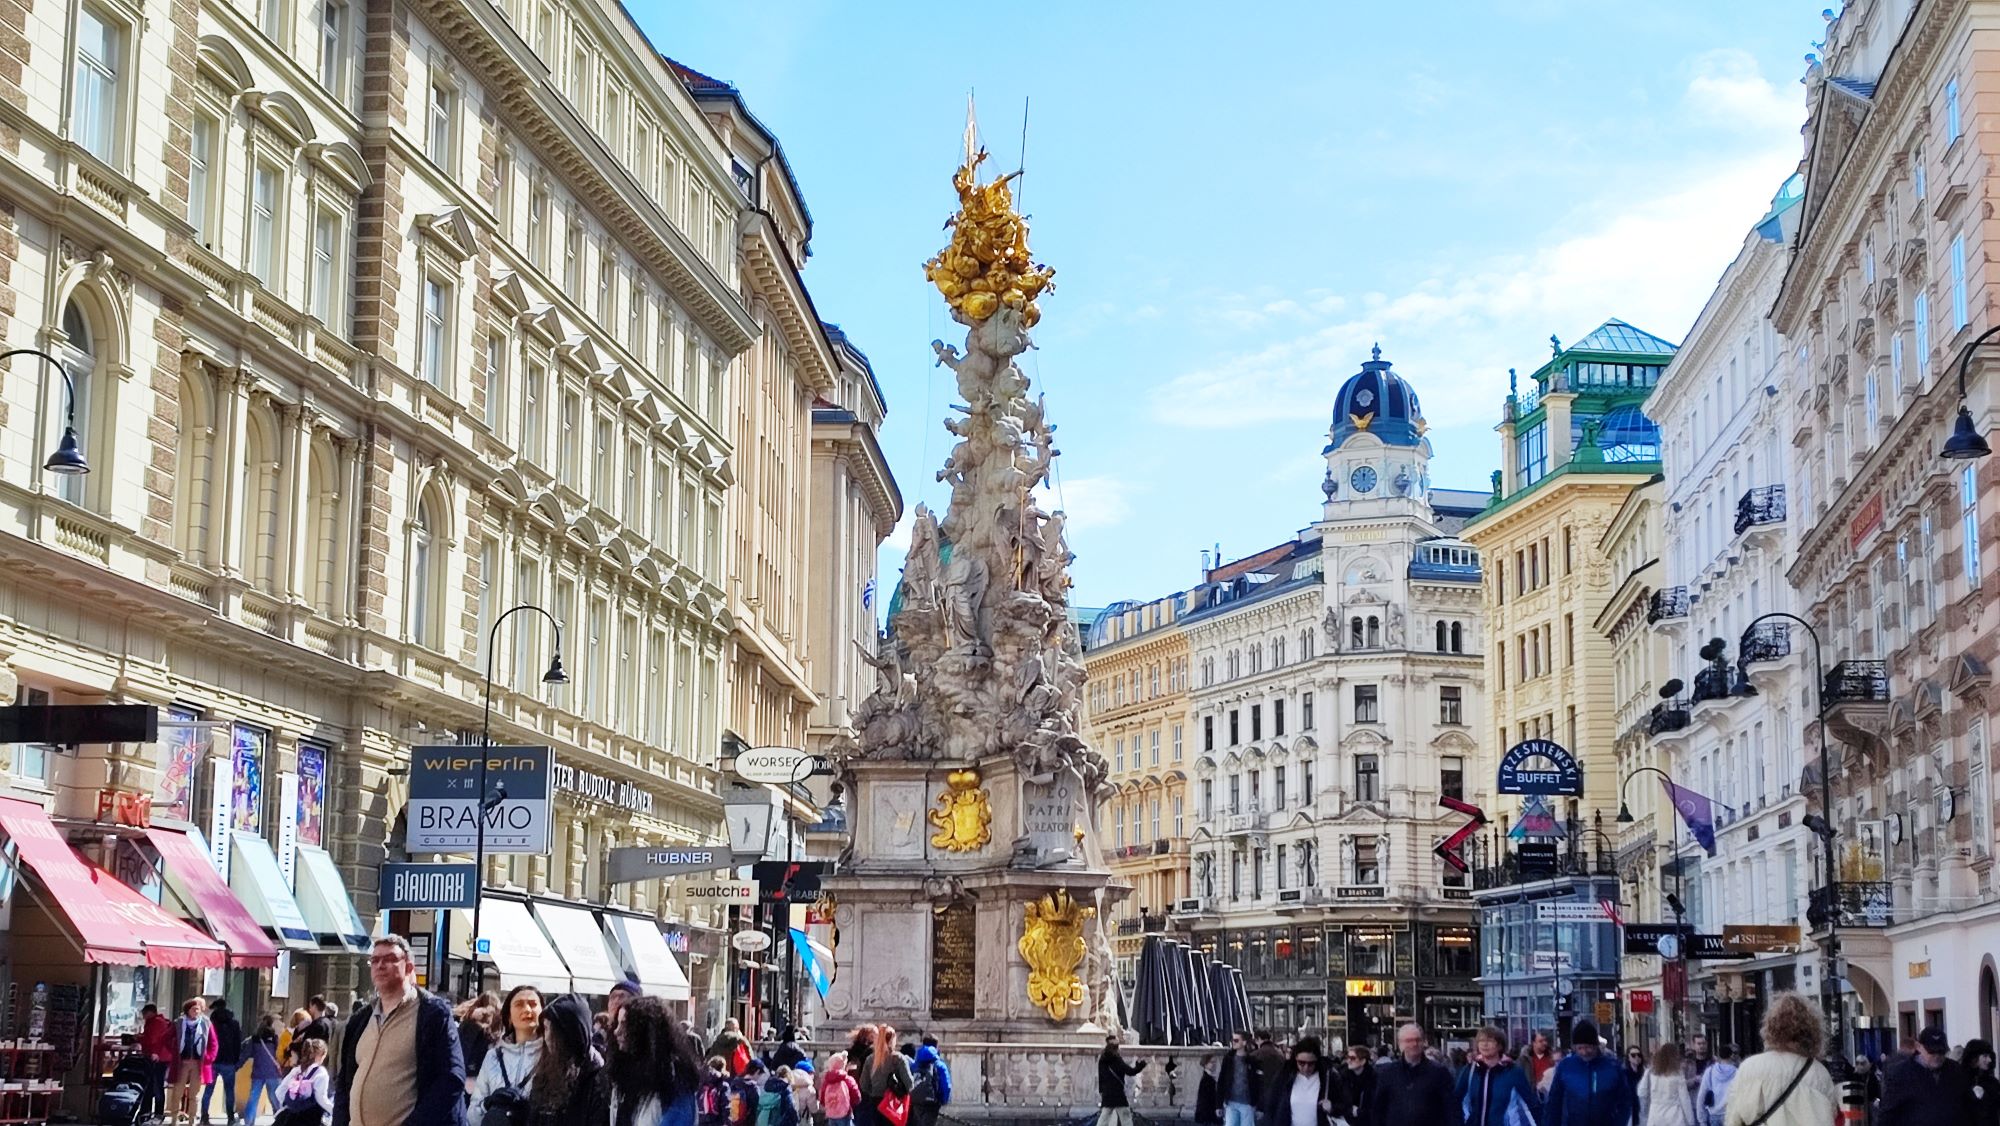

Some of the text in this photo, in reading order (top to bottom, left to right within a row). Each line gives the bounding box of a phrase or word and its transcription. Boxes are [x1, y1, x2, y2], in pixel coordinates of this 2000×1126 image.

[1516, 772, 1562, 783] BUFFET
[619, 780, 653, 814] HÜBNER
[1028, 803, 1071, 816] PATRI
[420, 805, 532, 830] BRAMO
[646, 851, 713, 864] HÜBNER
[686, 885, 740, 897] swatch
[790, 890, 827, 900] RABEN
